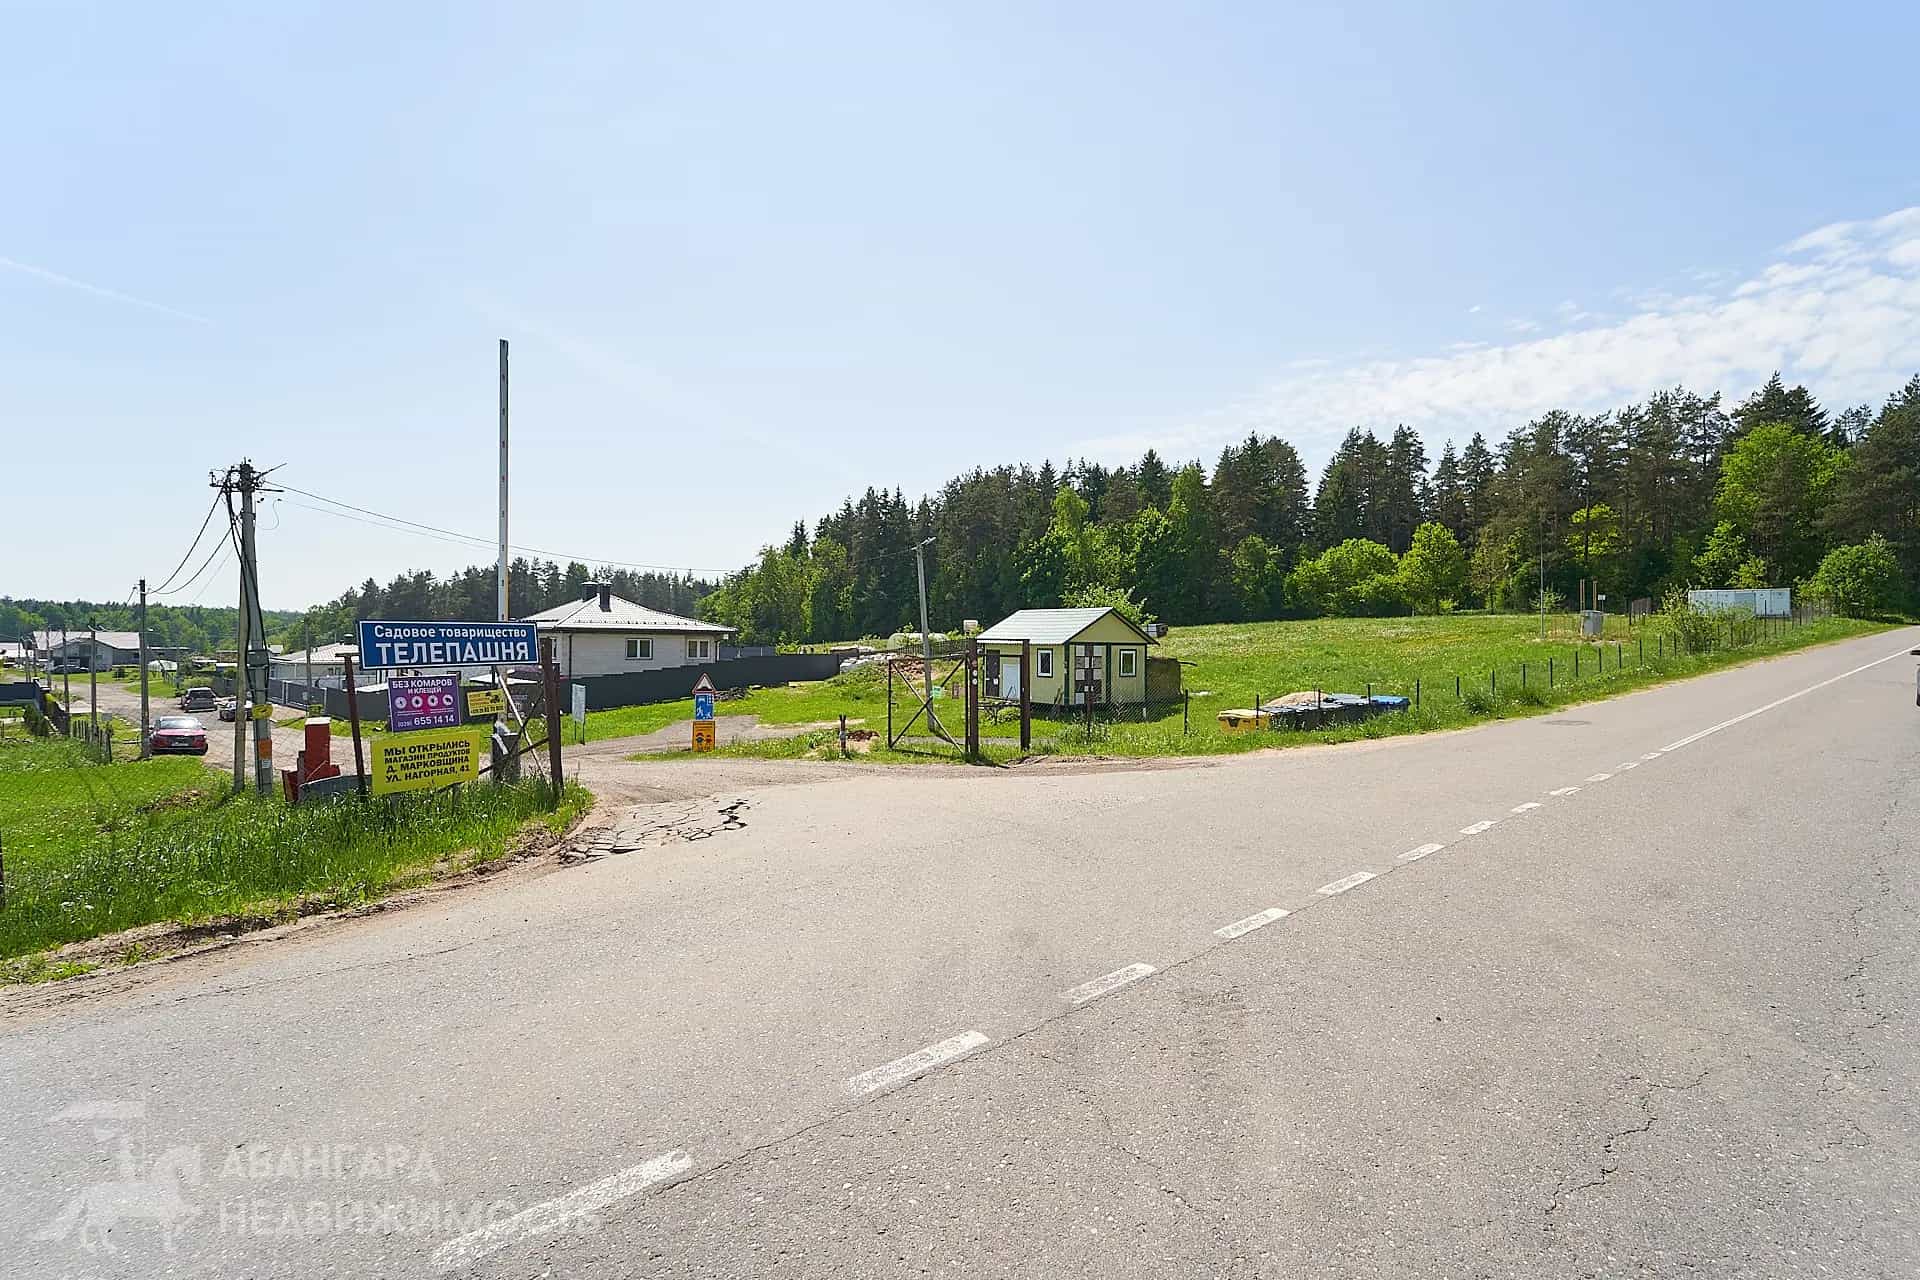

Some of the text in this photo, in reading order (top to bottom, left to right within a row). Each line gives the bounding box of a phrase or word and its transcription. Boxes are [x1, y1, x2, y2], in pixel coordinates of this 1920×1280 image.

[374, 625, 527, 640] Садовое товарищество
[375, 642, 529, 665] ТЕЛЕПАШНЯ
[392, 678, 453, 689] БЕЗ КОМАРОВ
[414, 716, 432, 726] 655
[434, 715, 443, 724] 14
[445, 714, 454, 723] 14
[384, 739, 471, 757] МЫ ОТКРЫЛИСЬ
[384, 748, 471, 764] МАГАЗИН ПРОДУКТОВ
[400, 755, 469, 771] МАРКОВЩИНА
[385, 774, 402, 783] УЛ.
